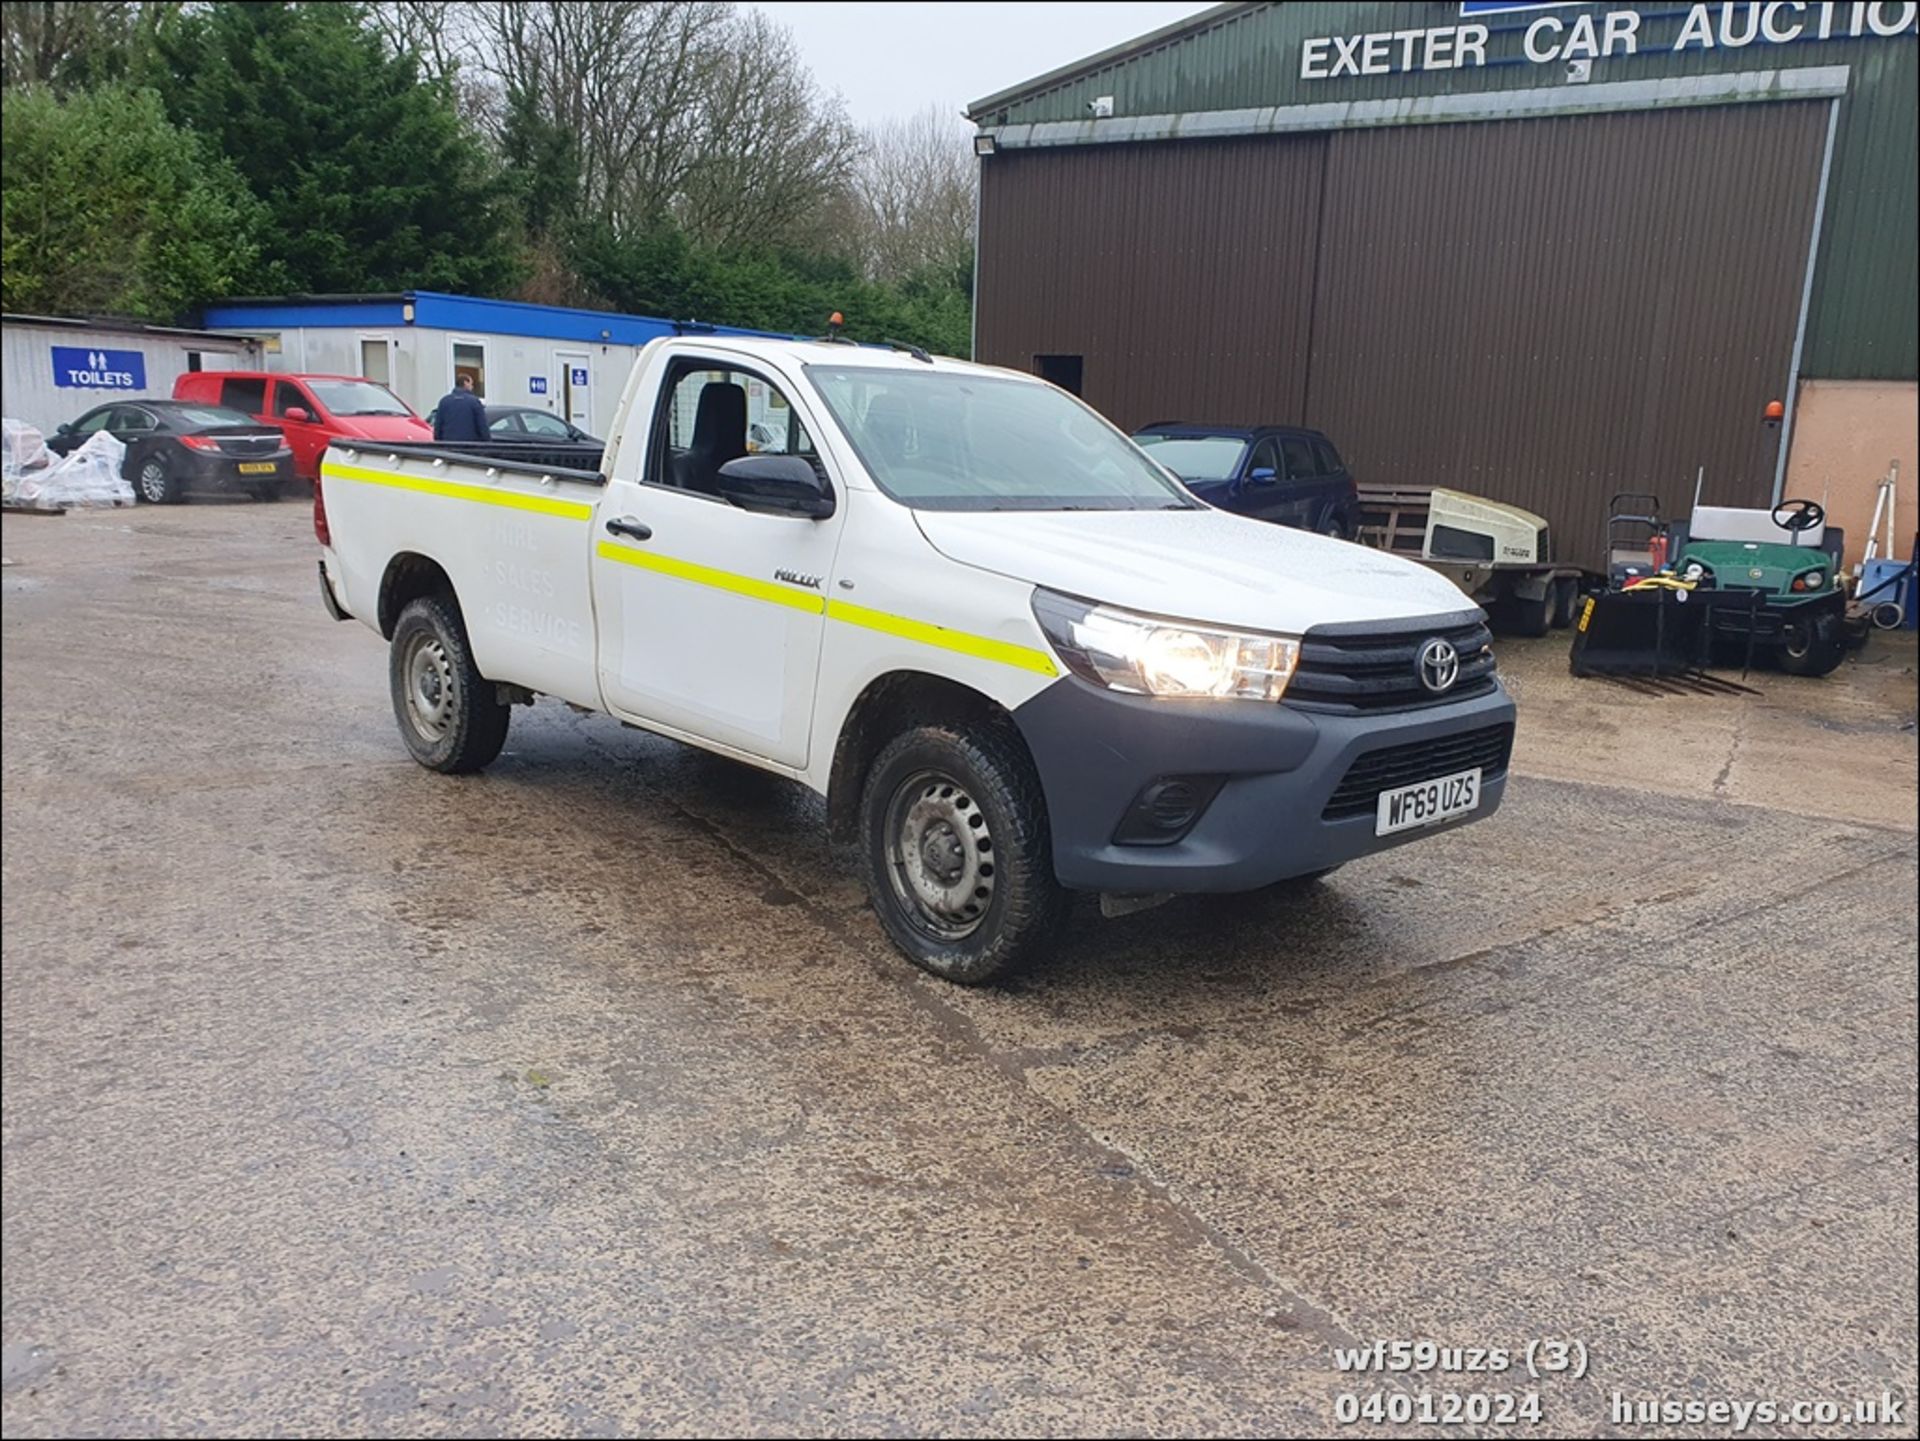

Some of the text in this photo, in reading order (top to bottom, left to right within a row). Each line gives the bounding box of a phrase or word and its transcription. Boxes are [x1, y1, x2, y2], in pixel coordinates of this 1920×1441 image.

[1301, 2, 1918, 79] EXETER CAR AUCTIO
[68, 370, 133, 386] TOILETS
[495, 560, 553, 598] SALES
[774, 567, 824, 590] HILUX
[495, 602, 581, 647] SERVICE
[1389, 775, 1474, 826] WF69 UZS
